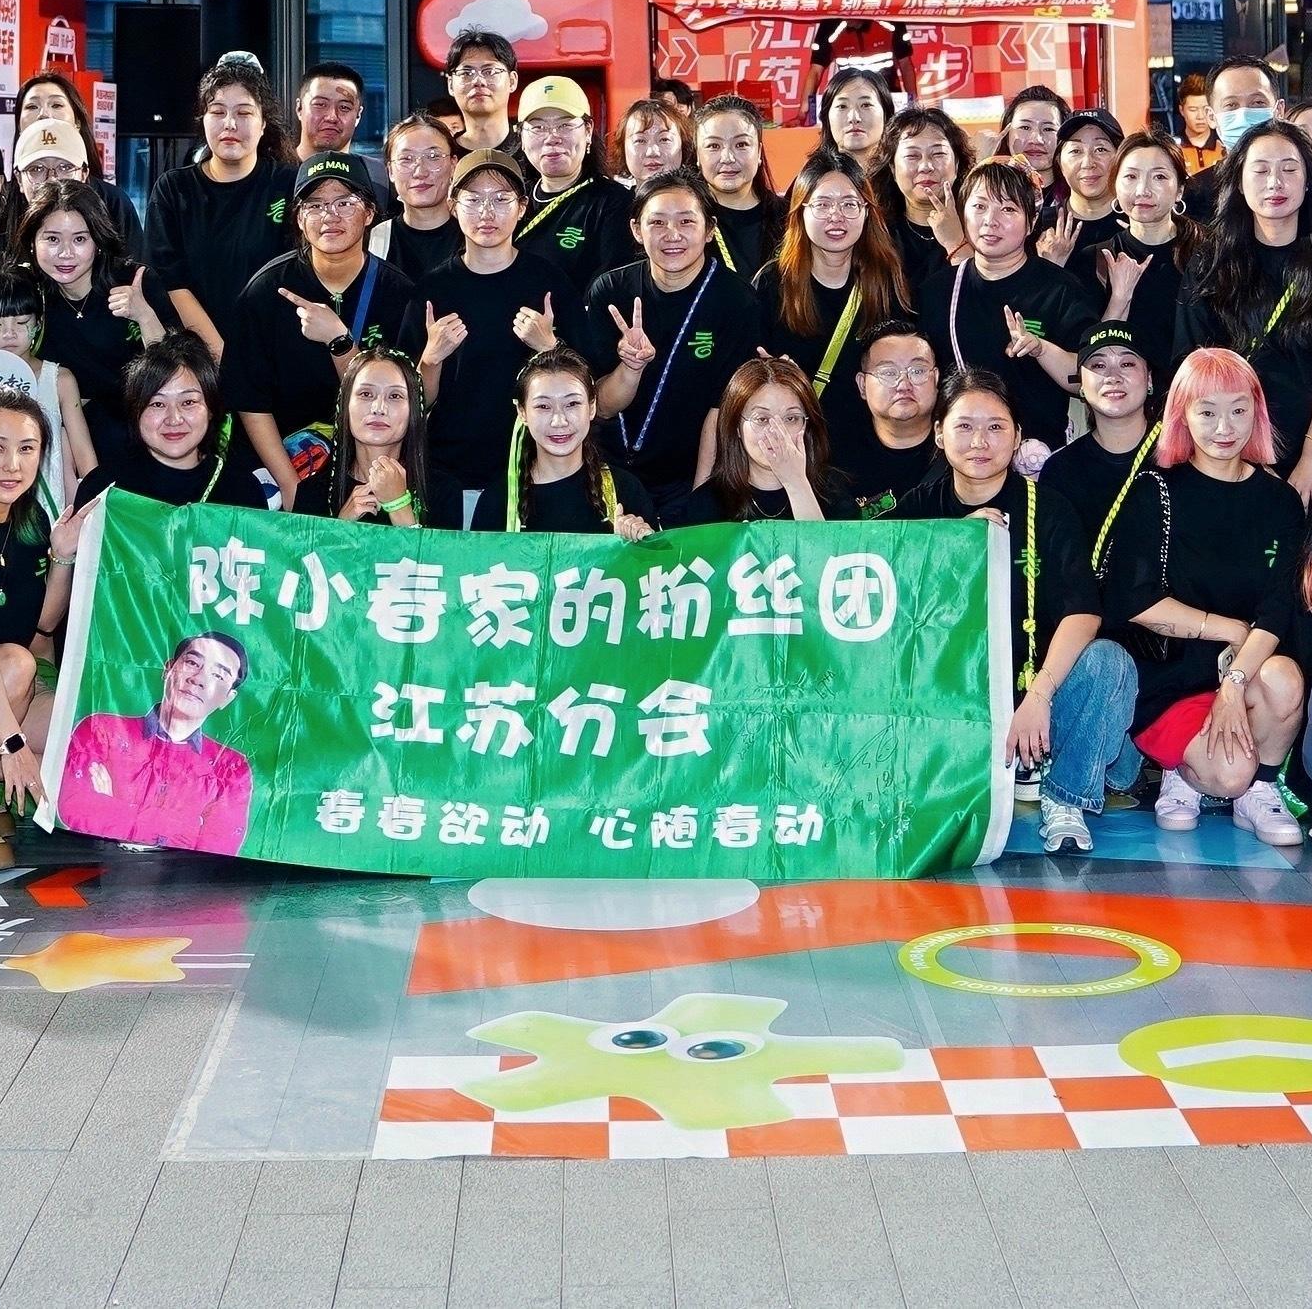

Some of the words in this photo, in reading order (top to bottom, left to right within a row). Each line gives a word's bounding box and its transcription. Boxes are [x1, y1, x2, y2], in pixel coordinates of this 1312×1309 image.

[307, 162, 324, 177] BIG
[325, 161, 350, 174] MAN
[1090, 329, 1107, 345] BIG
[1108, 328, 1133, 342] MAN
[187, 533, 899, 649] 陈小春家的粉丝团
[370, 680, 716, 760] 江苏分会
[314, 789, 551, 846] 春春欲动
[588, 803, 825, 850] 心随春动
[1051, 925, 1169, 968] TAOBAOSHANGOU
[952, 976, 1147, 995] TAOBAOSHANGOU
